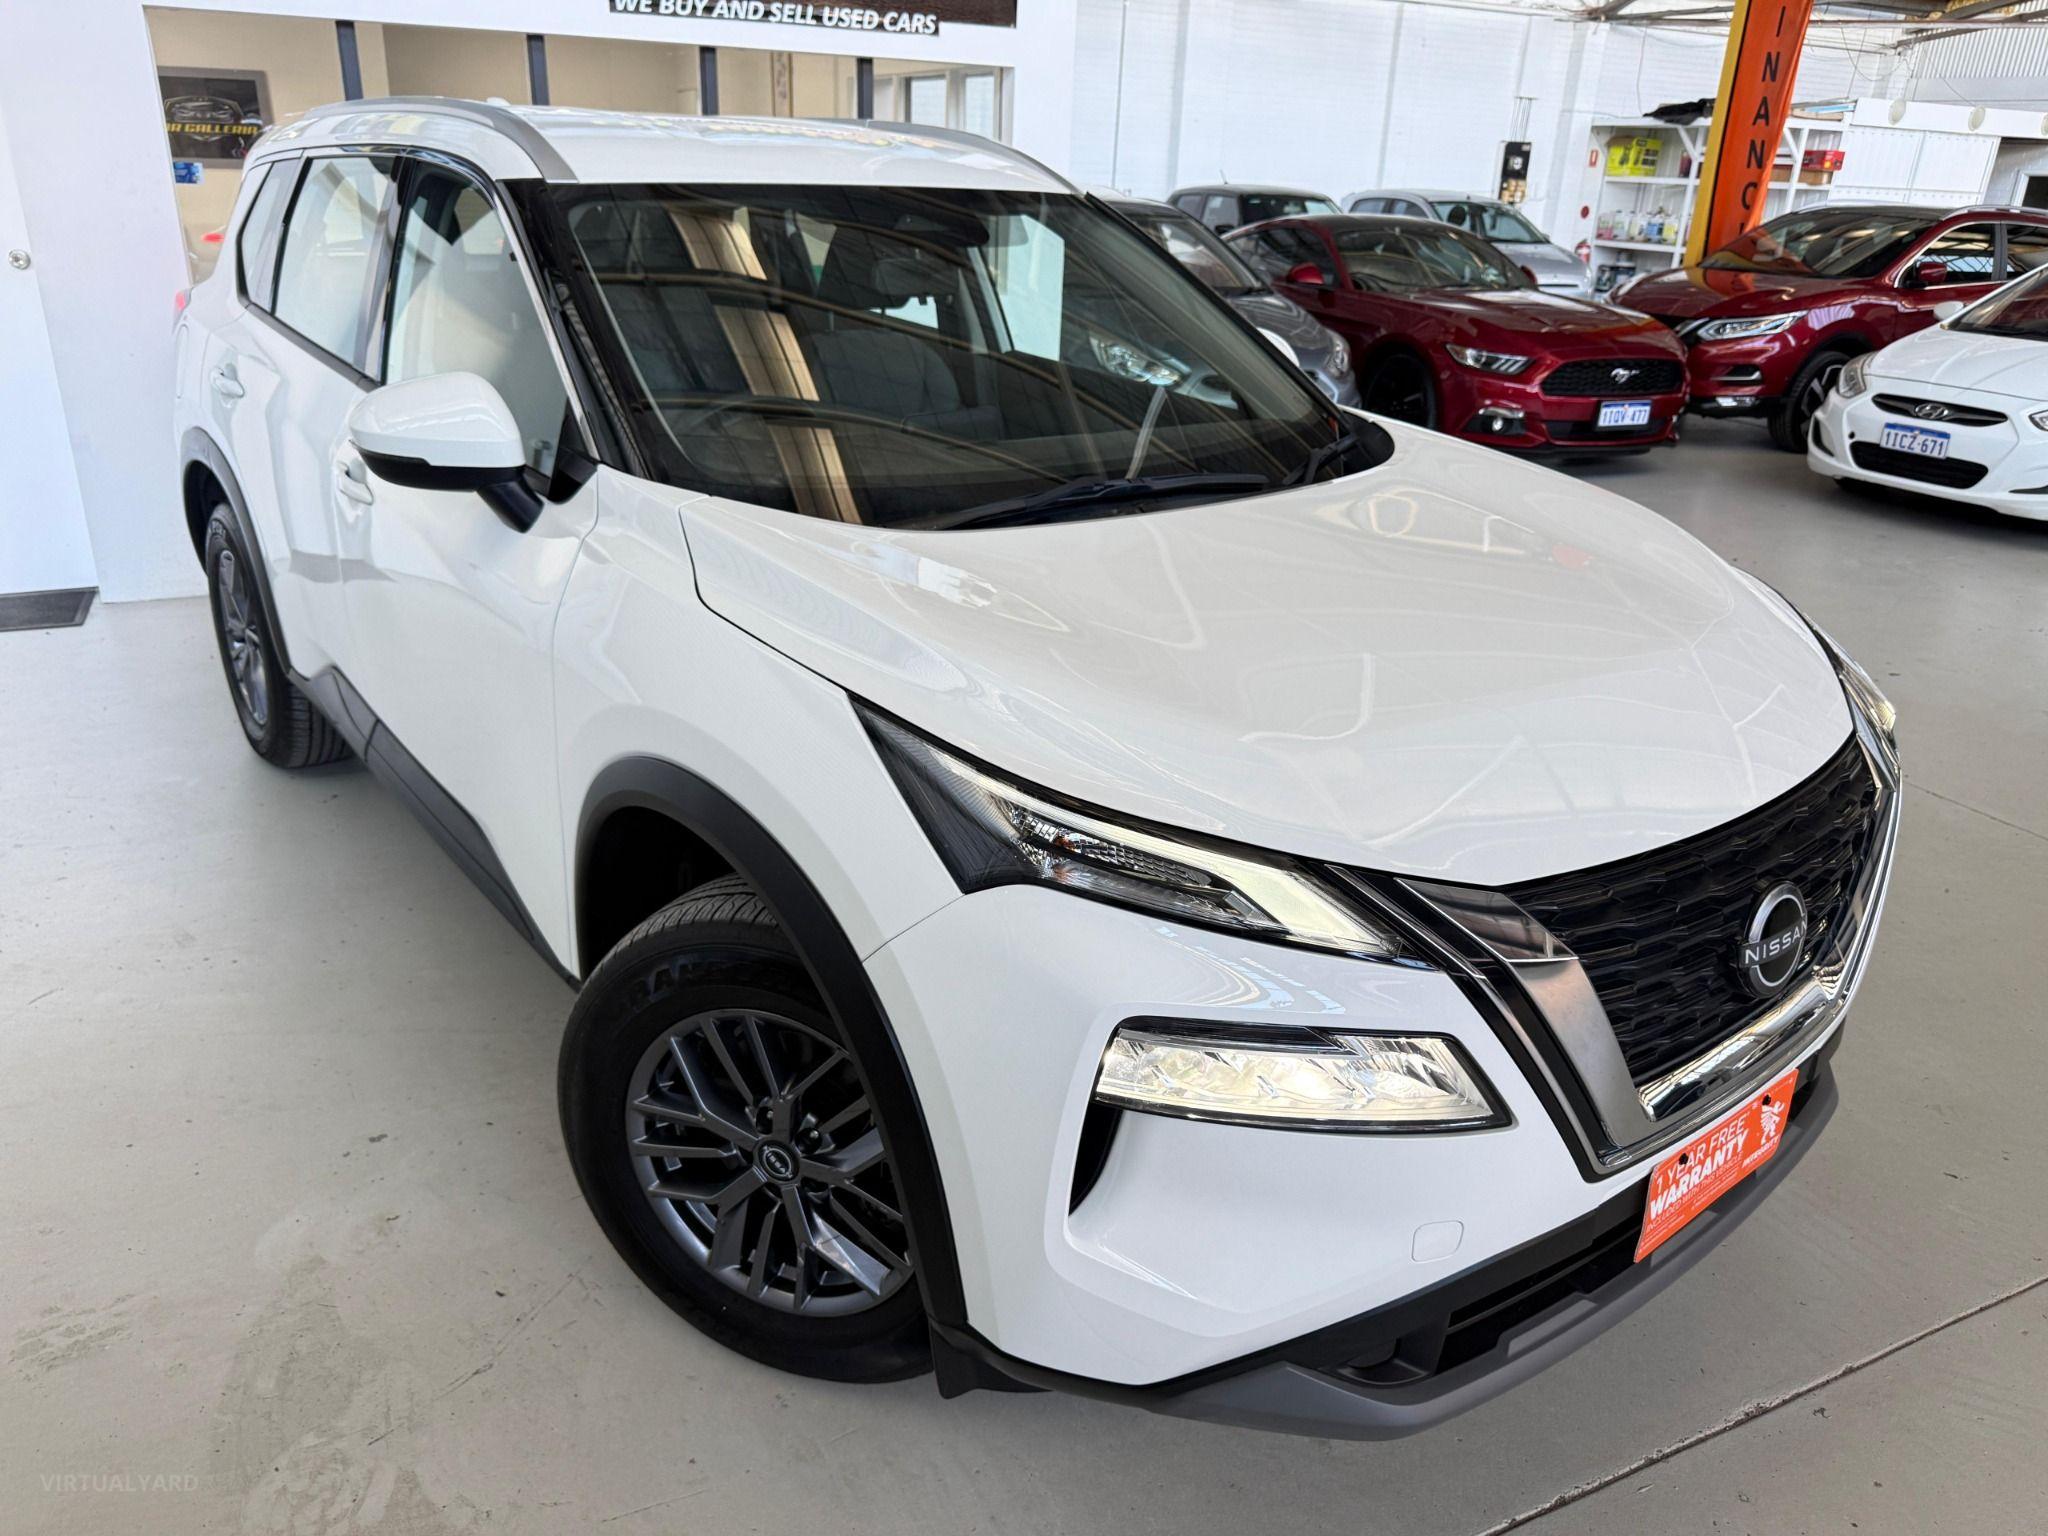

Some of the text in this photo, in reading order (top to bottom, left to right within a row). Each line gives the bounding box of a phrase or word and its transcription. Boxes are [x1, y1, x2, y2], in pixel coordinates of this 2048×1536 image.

[614, 0, 937, 34] WE BUY AND SELL USED CARS
[184, 123, 258, 135] GALLERIA
[1739, 6, 1786, 235] INANC
[1745, 920, 1807, 965] NISSAN
[1650, 1128, 1749, 1220] WARRANTY
[1657, 1175, 1663, 1194] 1
[1668, 1143, 1706, 1185] YEAR
[1709, 1113, 1746, 1154] FREE
